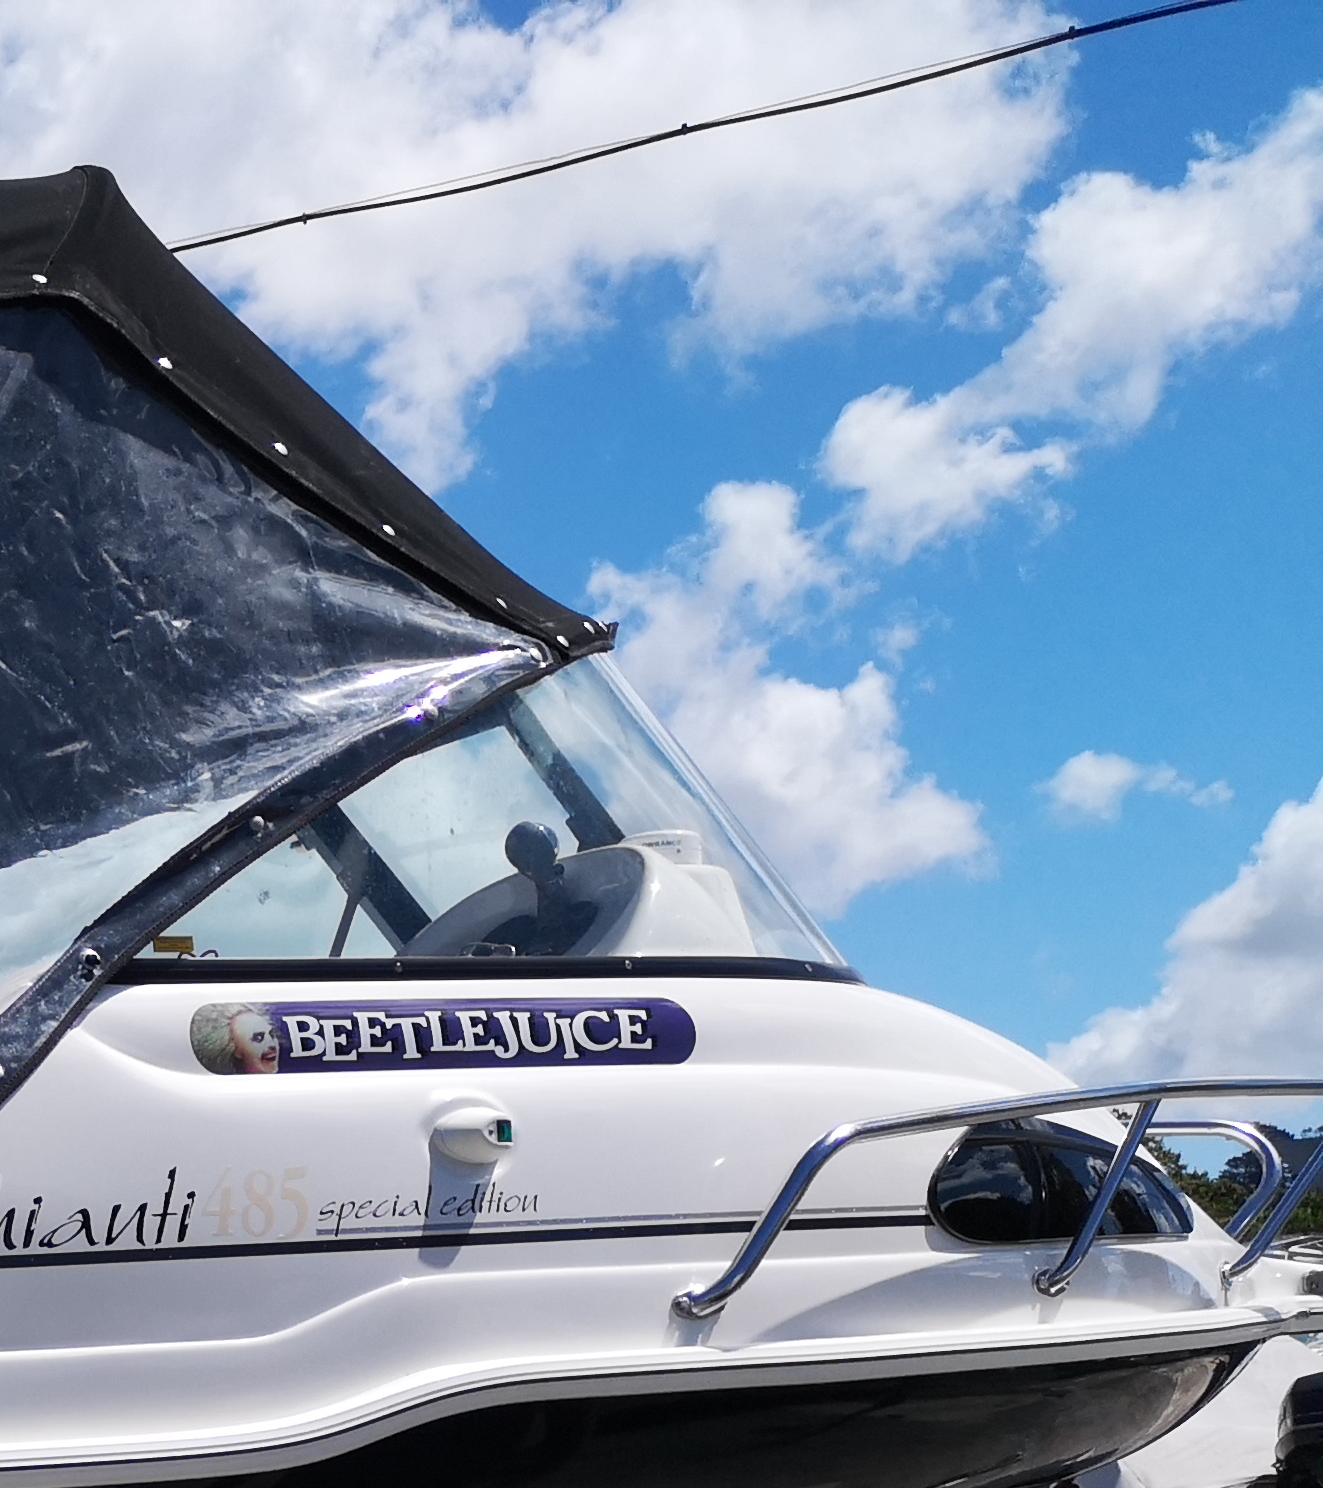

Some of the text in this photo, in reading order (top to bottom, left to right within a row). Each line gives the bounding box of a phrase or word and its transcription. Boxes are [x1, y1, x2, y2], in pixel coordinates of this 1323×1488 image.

[282, 1004, 655, 1064] BEETLEJUICE
[200, 1164, 309, 1240] 485
[317, 1184, 433, 1238] special
[440, 1181, 539, 1217] edition
